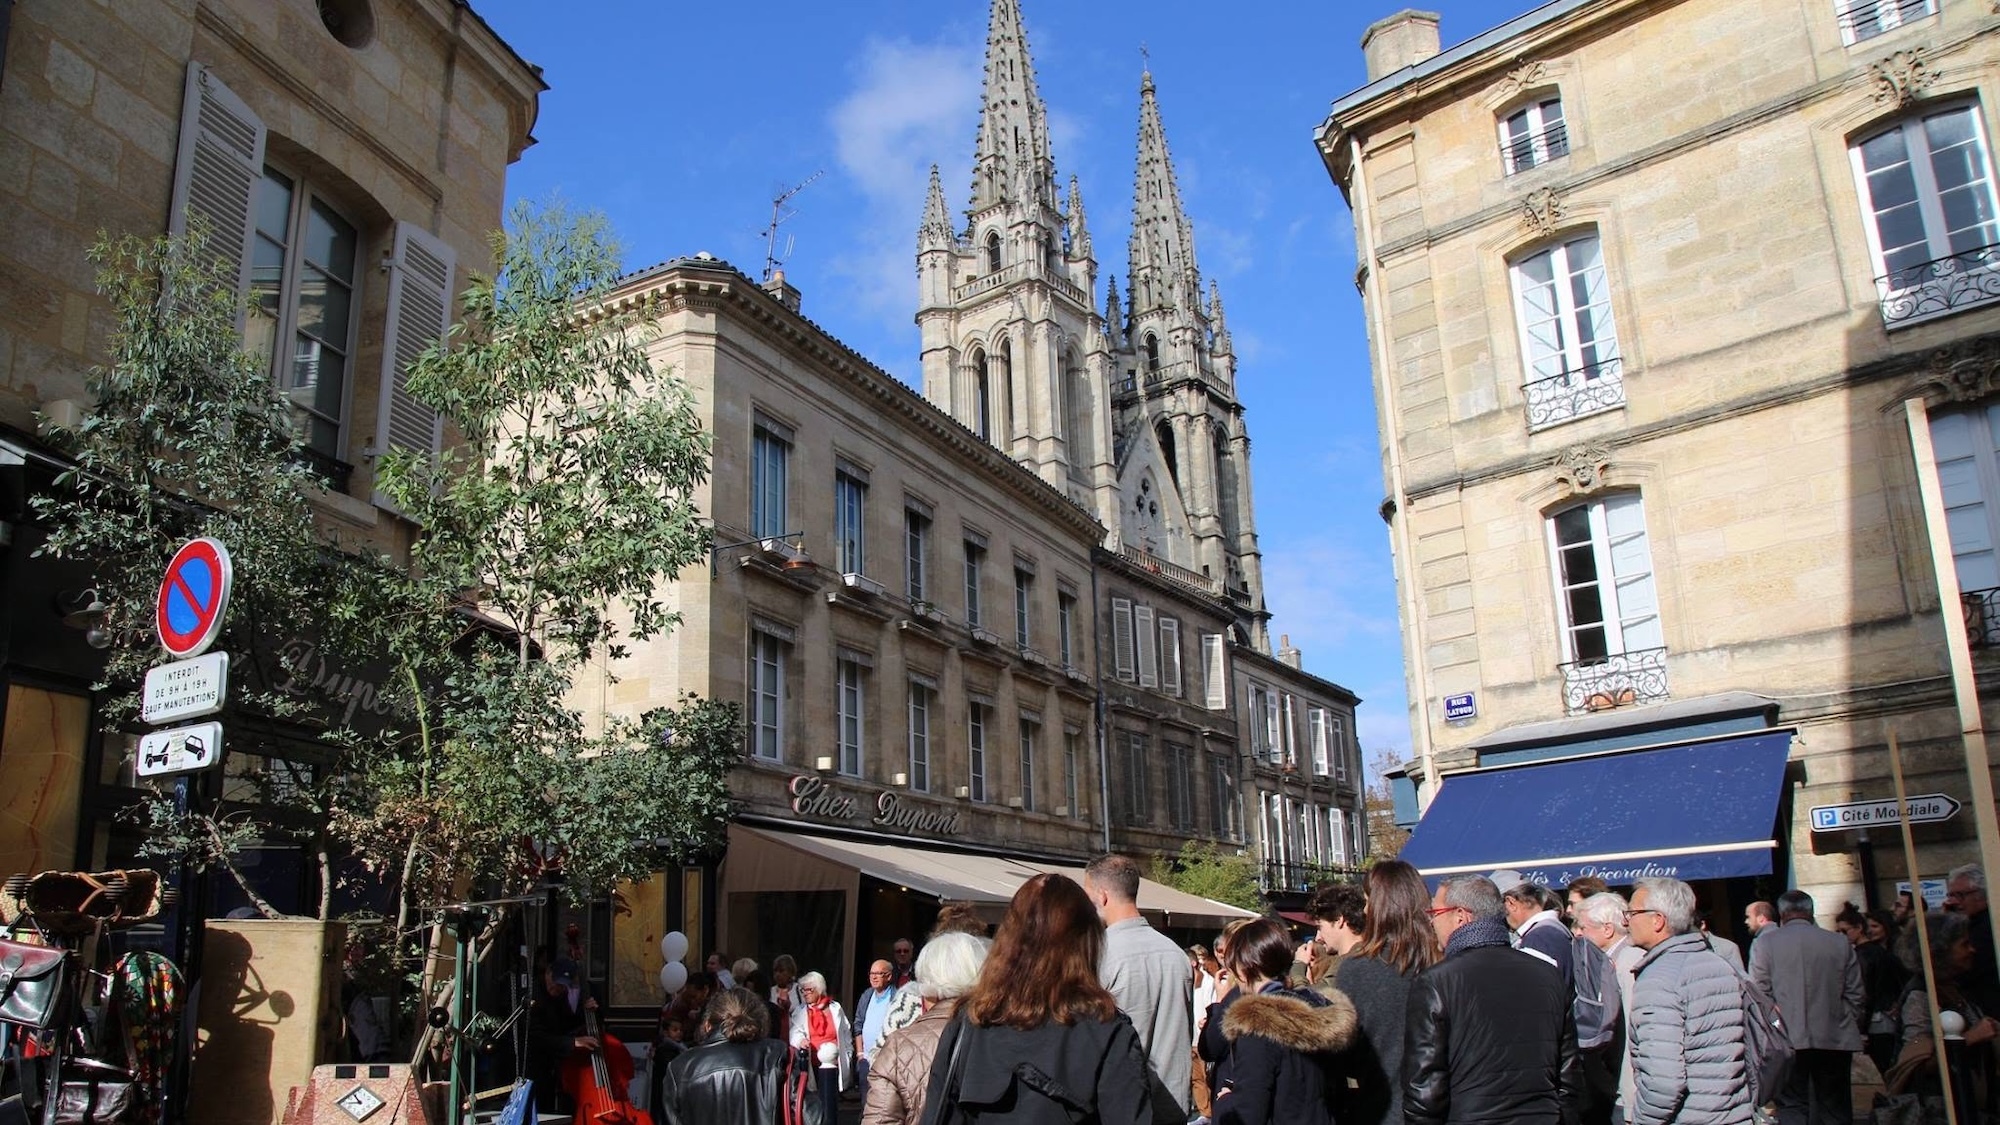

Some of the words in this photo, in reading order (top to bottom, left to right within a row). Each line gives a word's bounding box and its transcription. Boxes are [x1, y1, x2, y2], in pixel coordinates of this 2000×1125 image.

[164, 665, 200, 682] INTERDIT
[155, 688, 165, 699] DE
[145, 703, 161, 715] SAUF
[163, 690, 216, 710] MANUTENTIONS
[1451, 697, 1467, 706] RUE
[789, 775, 857, 819] Chez
[873, 790, 962, 835] Dupont
[1842, 808, 1870, 822] Cité
